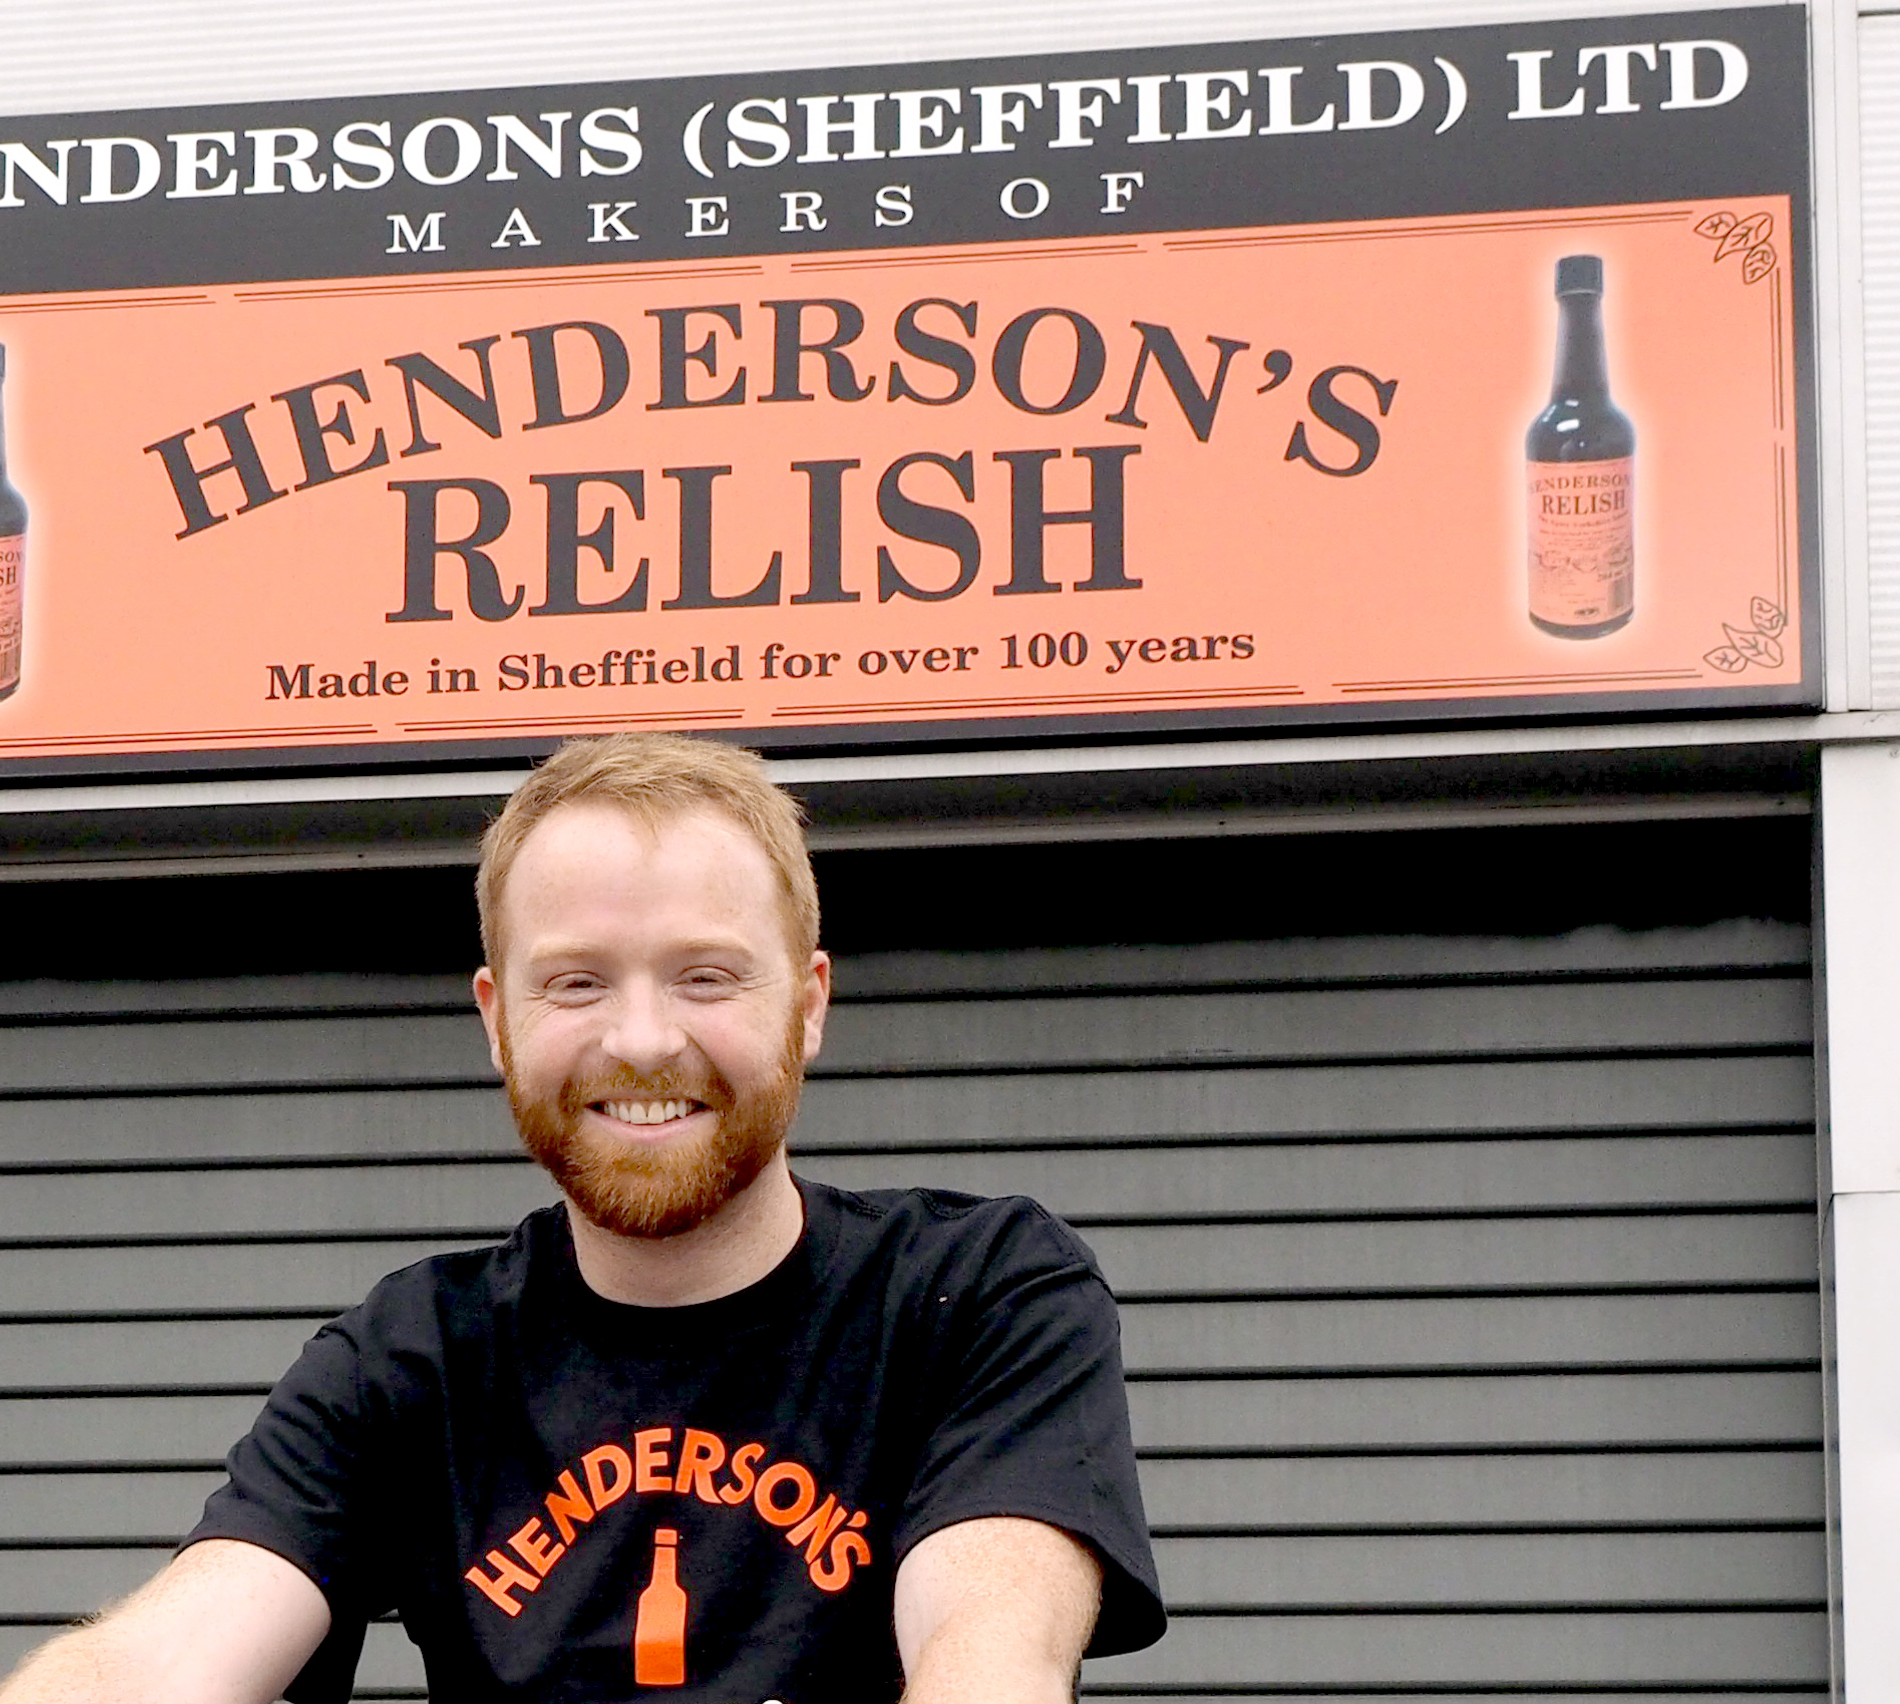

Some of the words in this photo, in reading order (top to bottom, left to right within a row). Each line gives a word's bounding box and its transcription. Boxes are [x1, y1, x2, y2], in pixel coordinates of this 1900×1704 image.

[682, 57, 1468, 178] (SHEFFIELD)
[1506, 38, 1750, 121] LTD
[386, 184, 915, 255] MAKERS
[999, 172, 1144, 219] OF
[142, 298, 1398, 538] HENDERSON'S
[385, 444, 1143, 623] RELISH
[1542, 489, 1626, 516] RELISH
[265, 662, 409, 702] Made
[426, 658, 479, 695] in
[498, 646, 743, 693] Sheffield
[758, 643, 840, 683] for
[857, 642, 978, 678] over
[999, 632, 1089, 670] 100
[1105, 629, 1256, 675] years
[464, 1427, 872, 1617] HENDERSON'S
